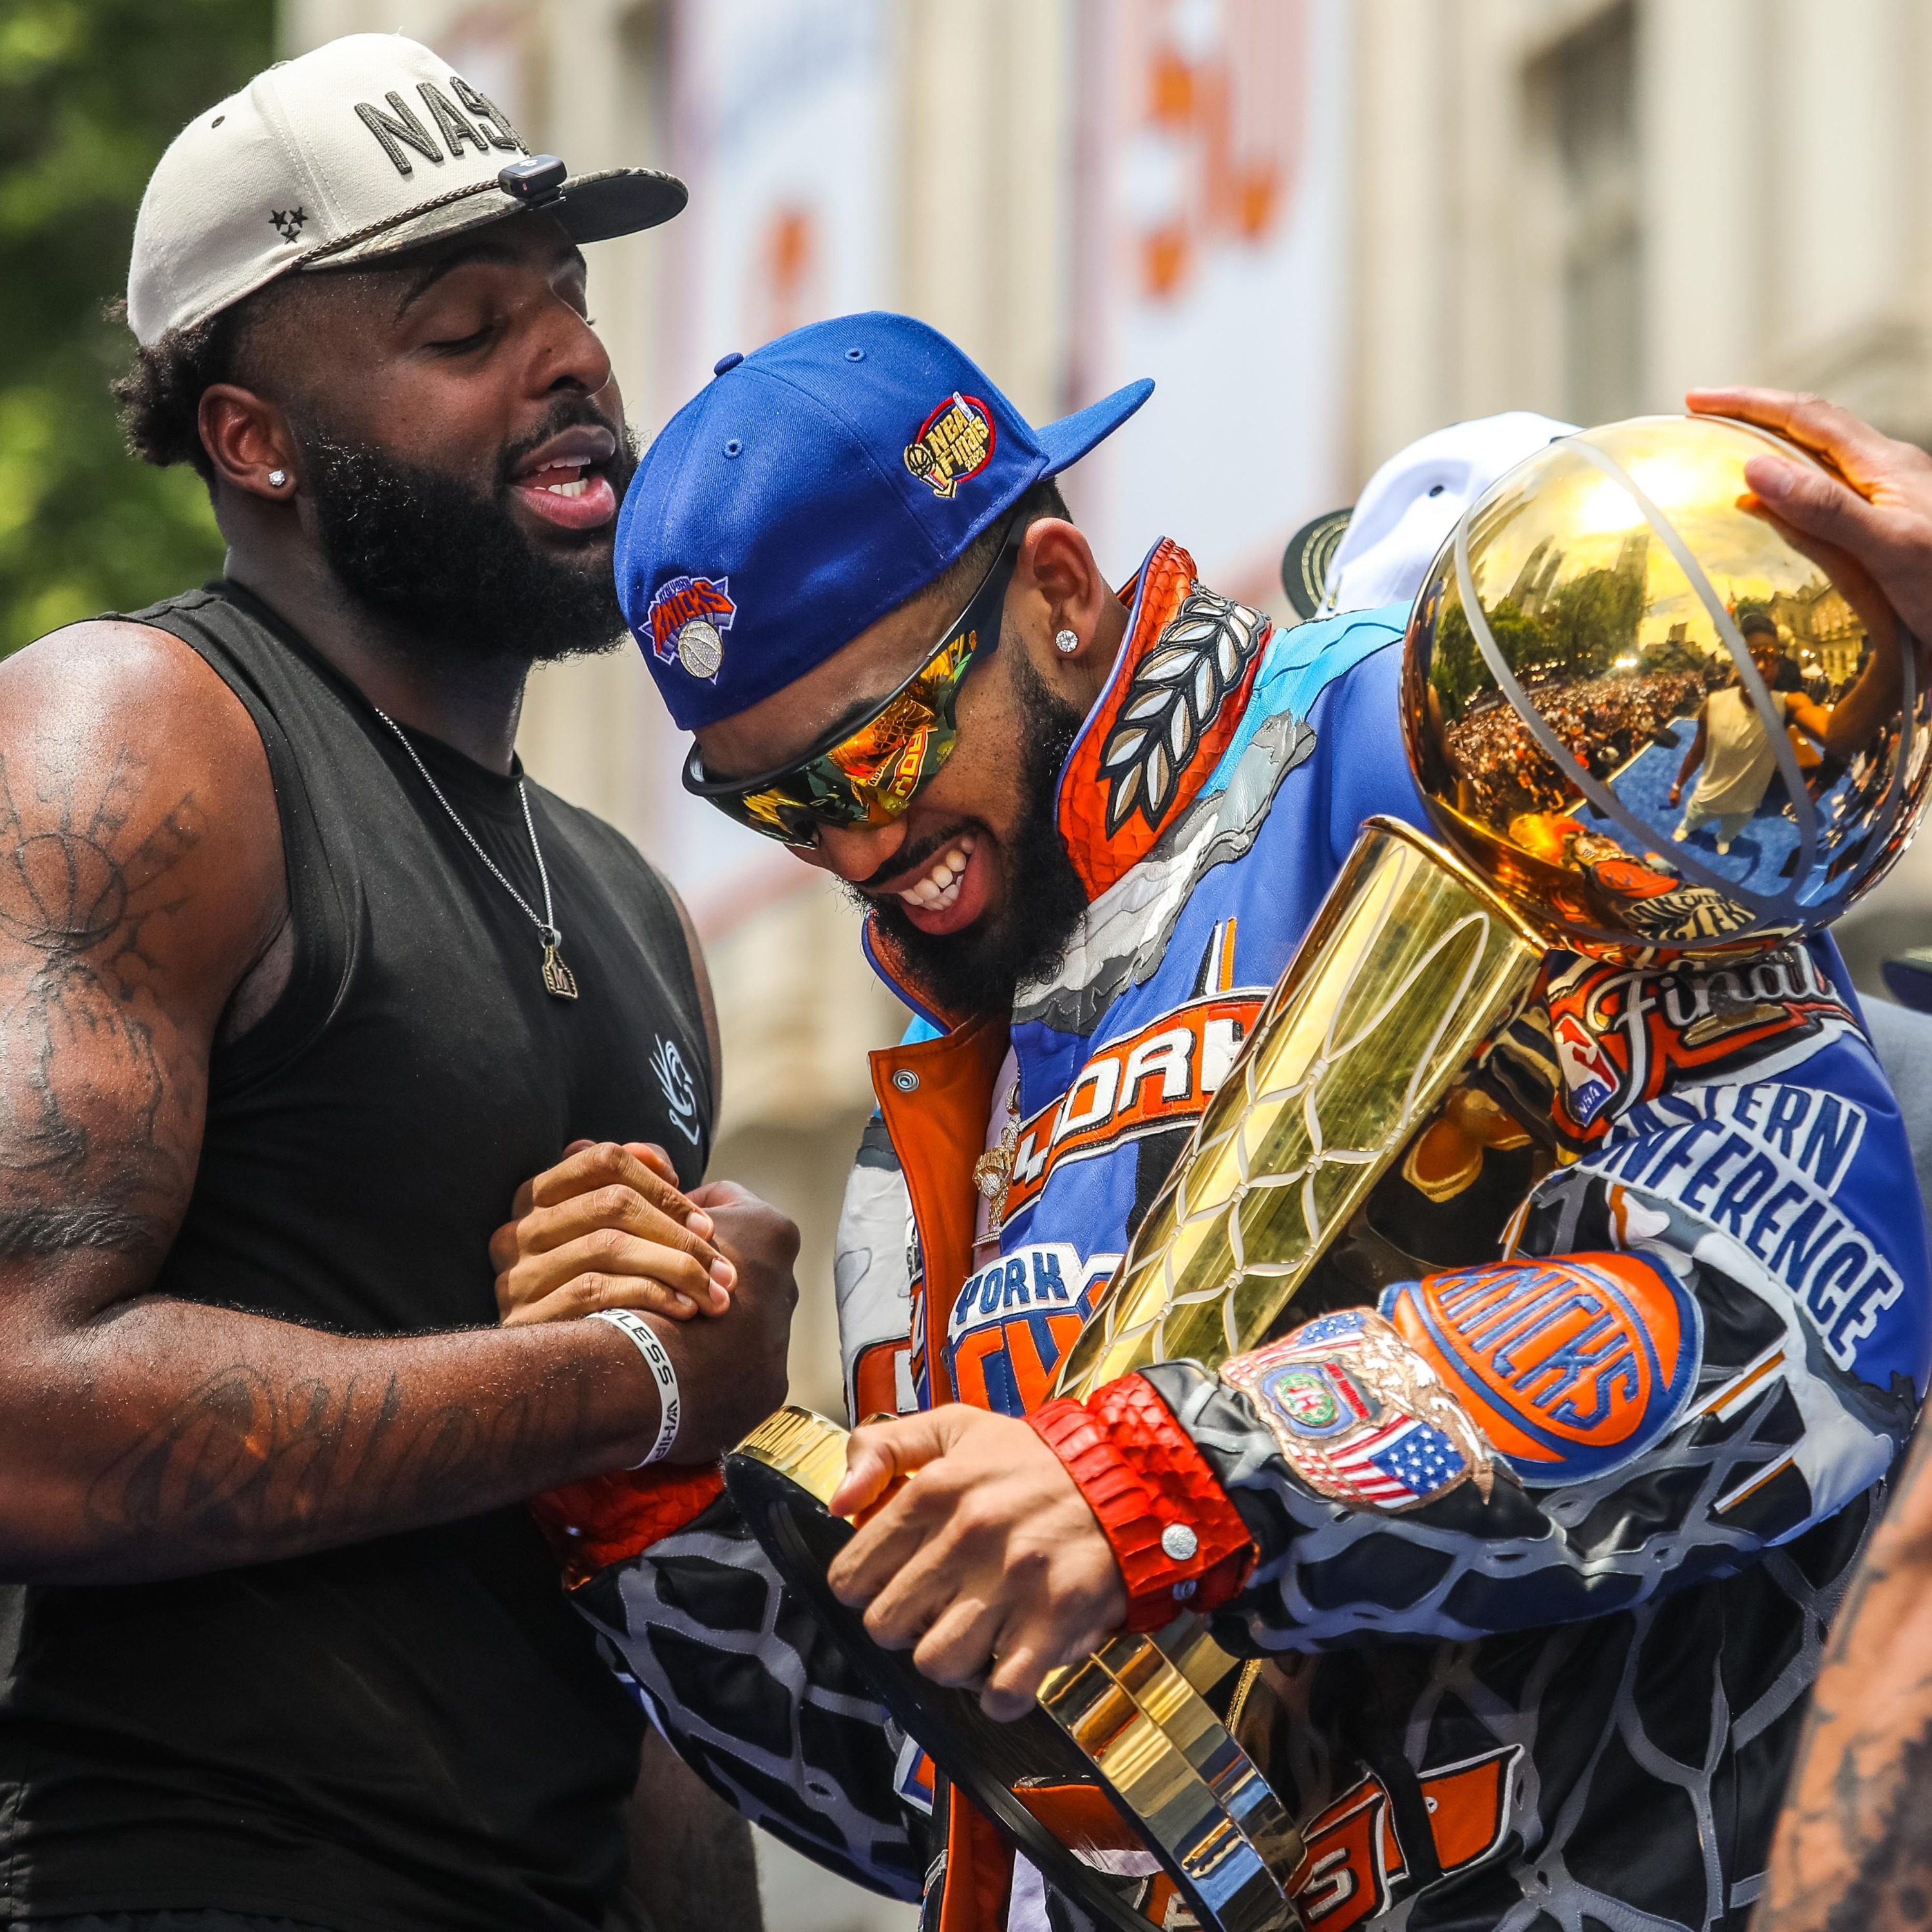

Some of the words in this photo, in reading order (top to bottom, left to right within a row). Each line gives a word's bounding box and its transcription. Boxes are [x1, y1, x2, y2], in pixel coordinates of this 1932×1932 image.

[354, 77, 531, 175] NAS
[925, 406, 969, 457] NBA
[936, 416, 989, 477] Finals
[651, 582, 734, 654] KNICKS
[956, 1253, 1069, 1325] YORK
[1433, 1264, 1639, 1431] KNICKS
